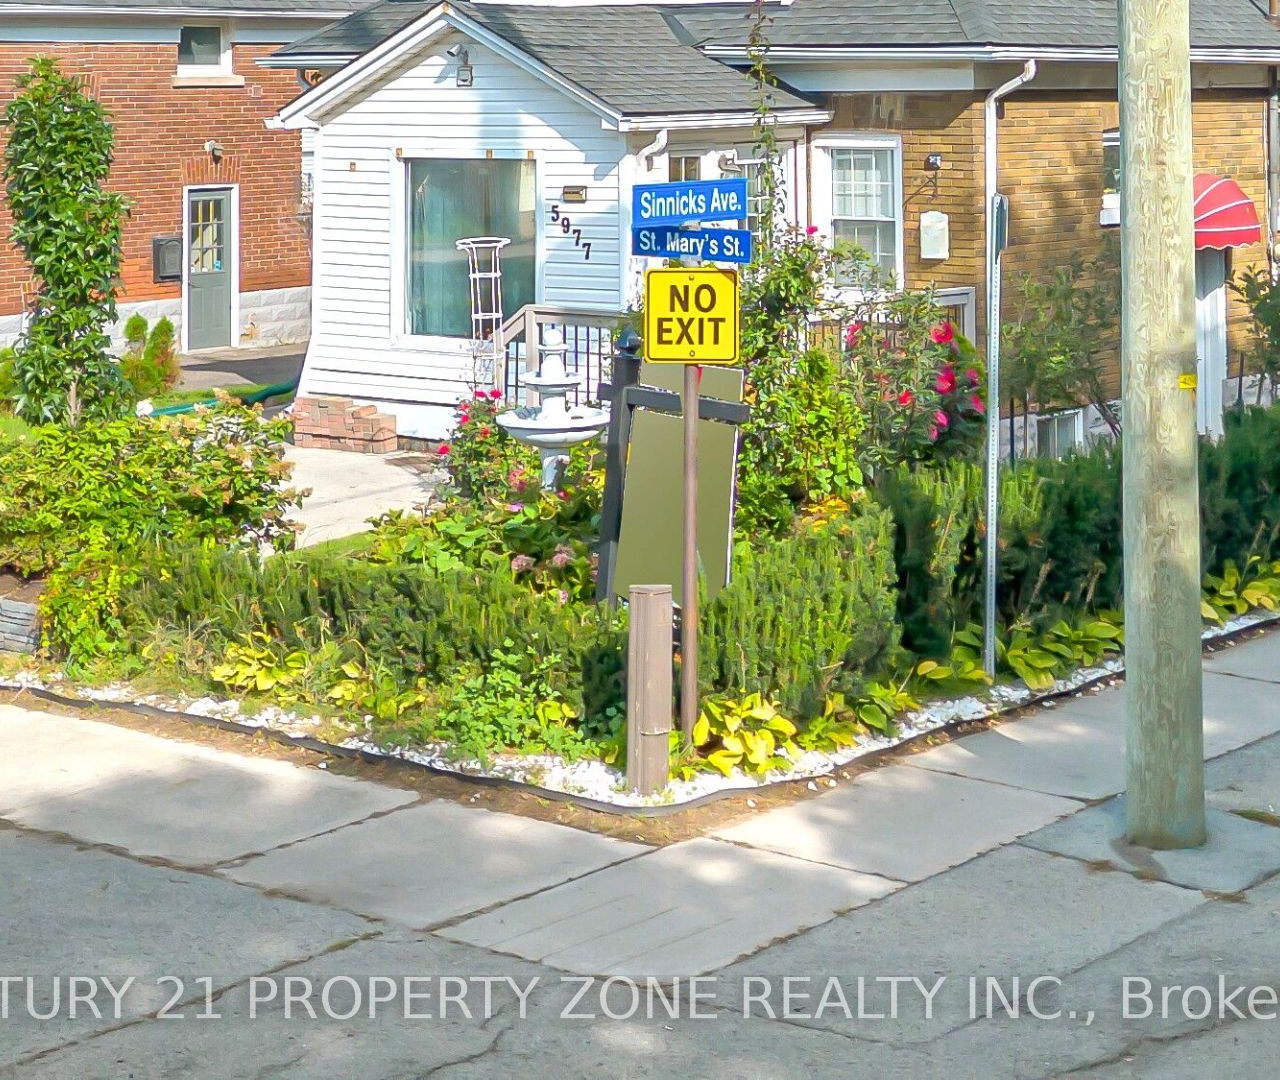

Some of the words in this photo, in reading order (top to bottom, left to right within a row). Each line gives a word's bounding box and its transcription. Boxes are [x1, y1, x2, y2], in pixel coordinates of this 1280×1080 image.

[640, 189, 706, 219] Sinnicks
[710, 187, 742, 213] Ave.
[551, 204, 592, 261] 5977
[639, 230, 661, 252] St.
[666, 232, 719, 257] Mary's
[723, 235, 745, 257] St.
[669, 283, 717, 313] NO
[656, 317, 726, 346] EXIT
